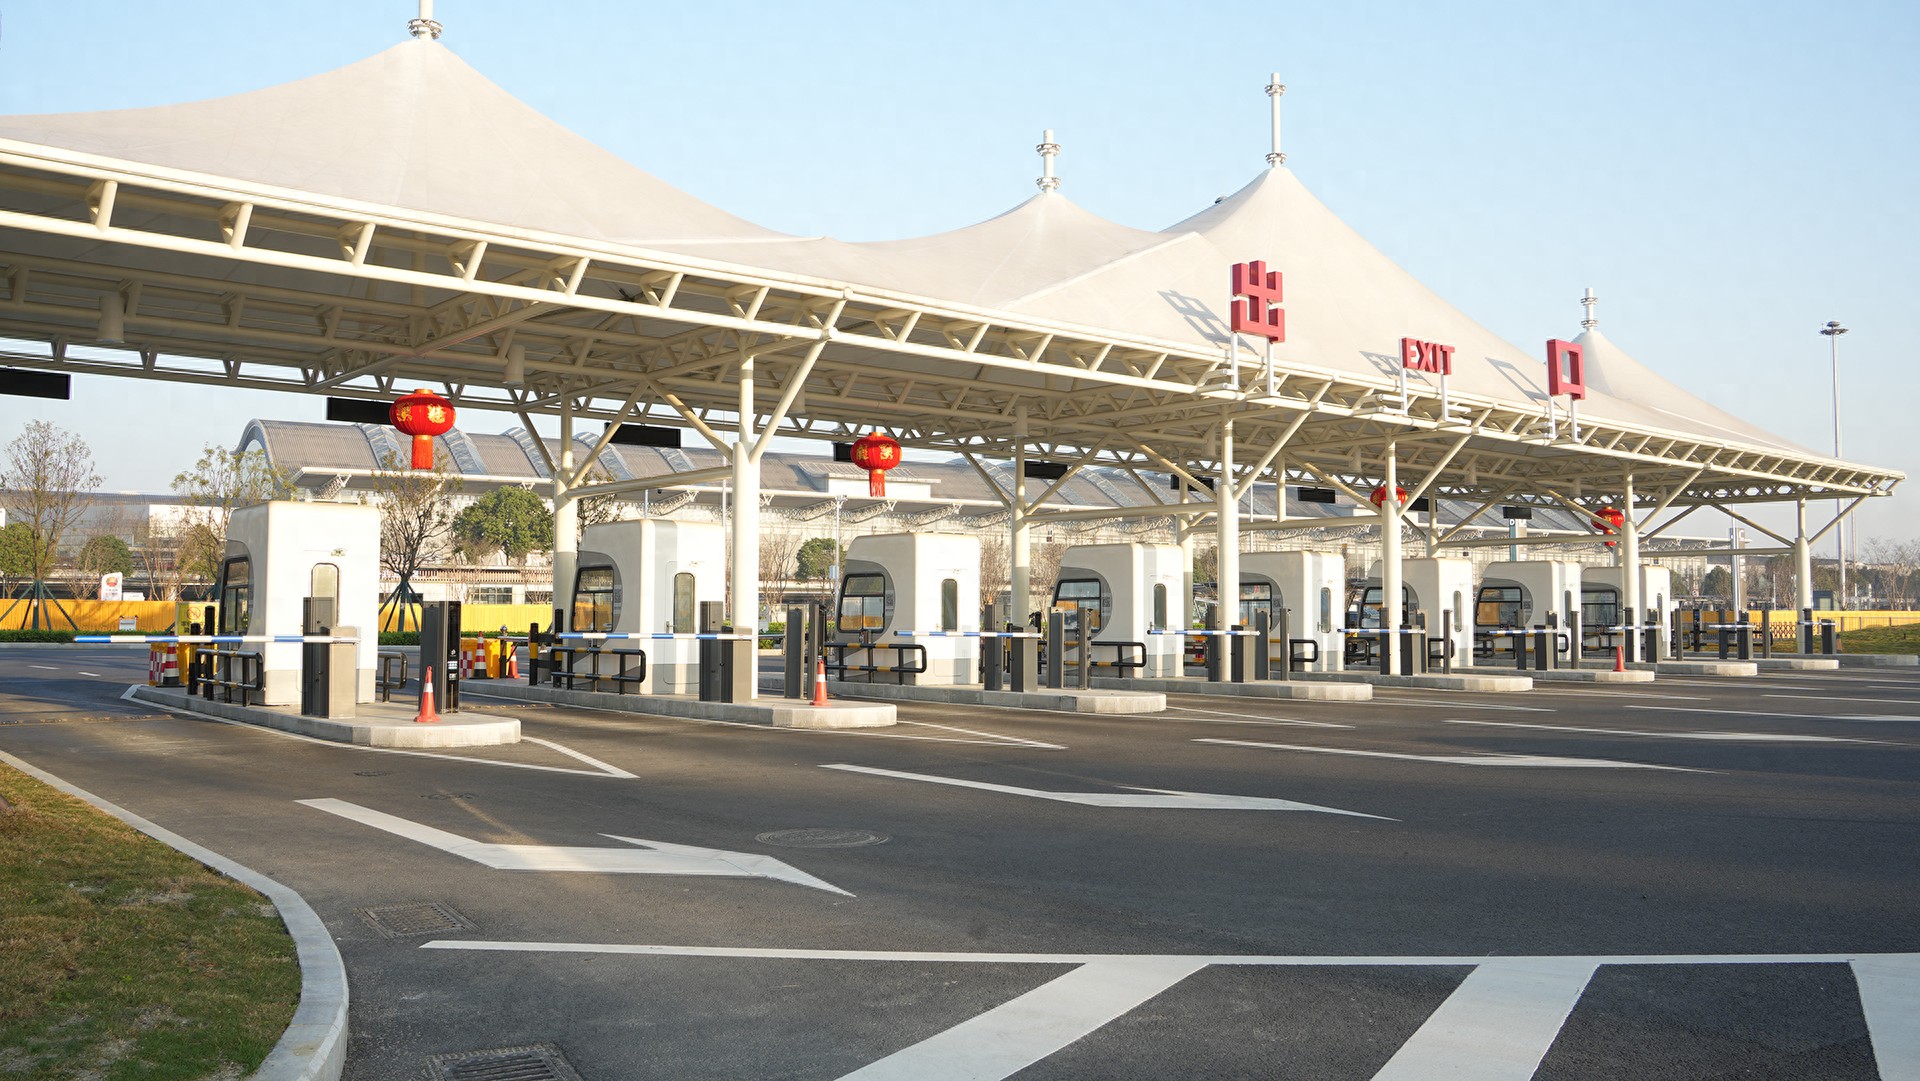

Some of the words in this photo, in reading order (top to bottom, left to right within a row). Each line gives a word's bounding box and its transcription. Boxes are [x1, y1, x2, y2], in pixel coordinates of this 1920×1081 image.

[1231, 261, 1285, 343] 出
[1402, 337, 1455, 375] EXIT
[1547, 339, 1585, 400] 口
